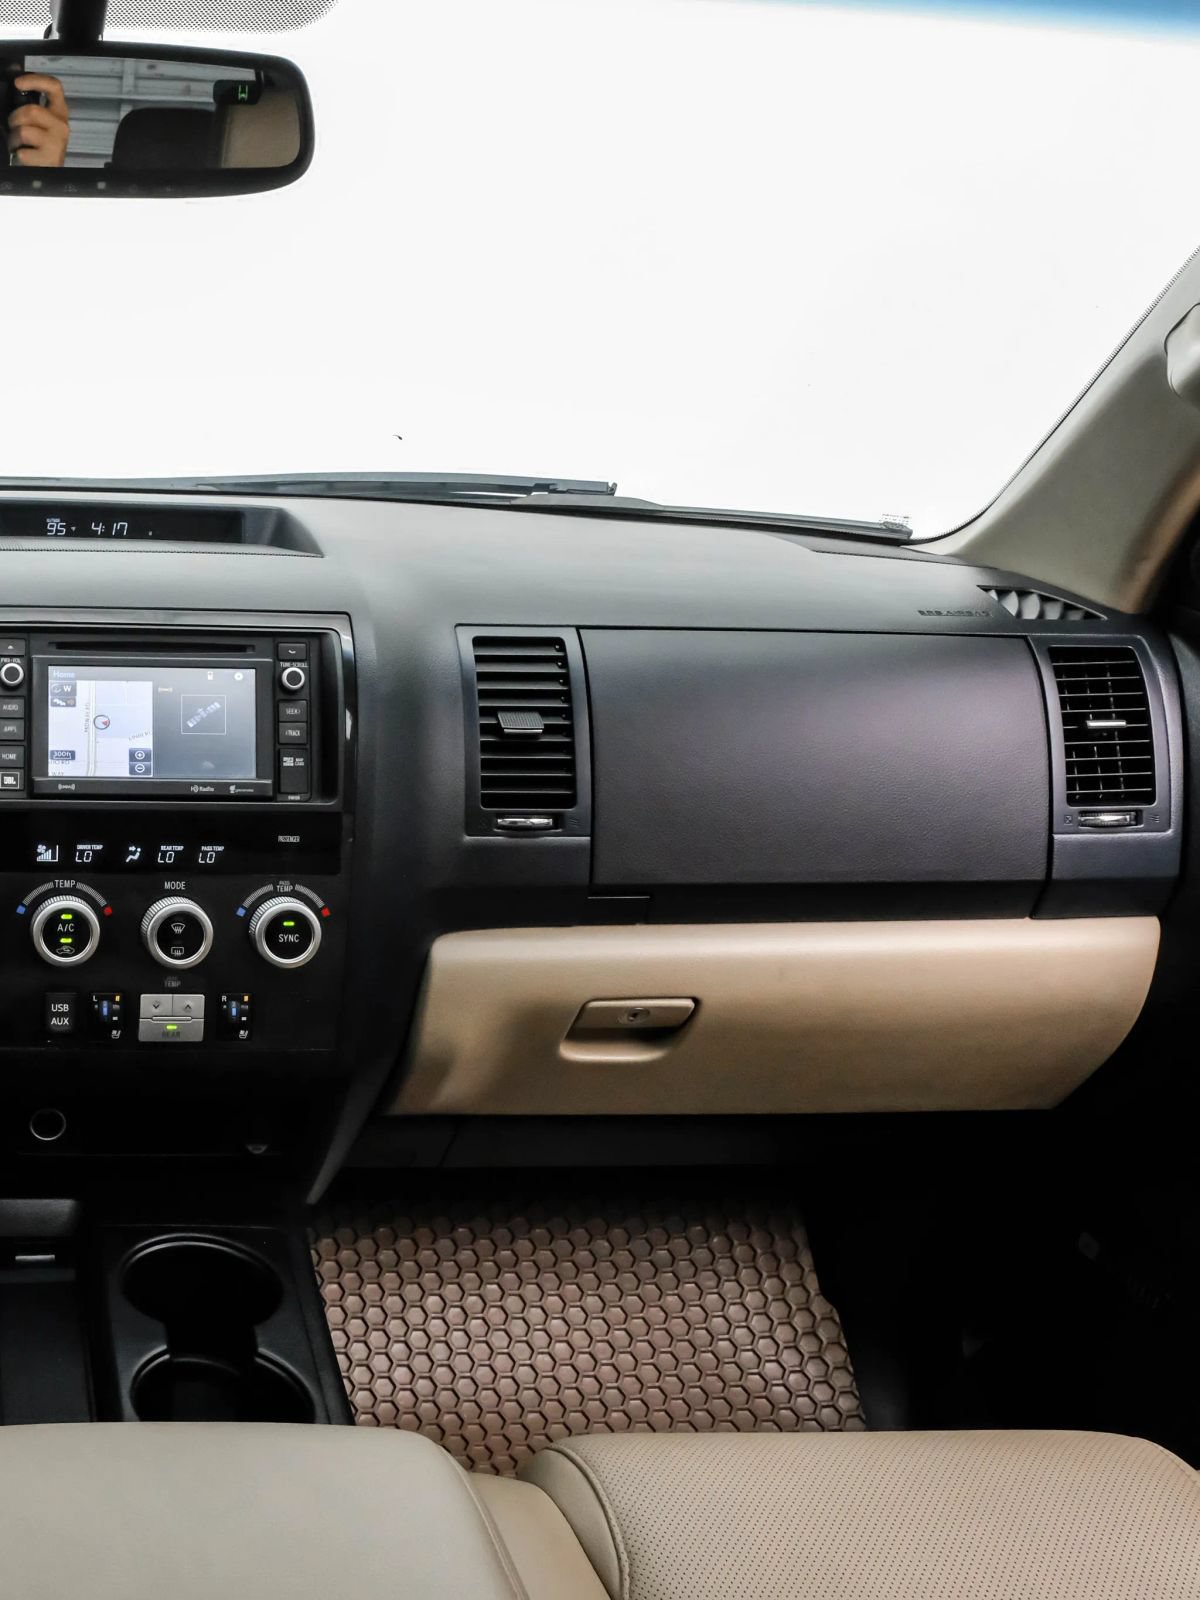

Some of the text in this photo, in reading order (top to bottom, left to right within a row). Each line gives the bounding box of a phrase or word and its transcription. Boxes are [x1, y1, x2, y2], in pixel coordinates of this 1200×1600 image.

[47, 522, 67, 535] 95
[91, 522, 128, 536] 4:17
[53, 670, 75, 679] Home
[75, 850, 93, 863] LO
[157, 851, 175, 863] LO
[198, 852, 216, 864] LO
[54, 880, 75, 888] TEMP
[164, 881, 186, 890] MODE
[276, 885, 294, 893] TEMP
[56, 923, 75, 933] A/C
[278, 933, 300, 943] SYNC
[51, 1003, 69, 1012] USB
[51, 1017, 69, 1025] AUX
